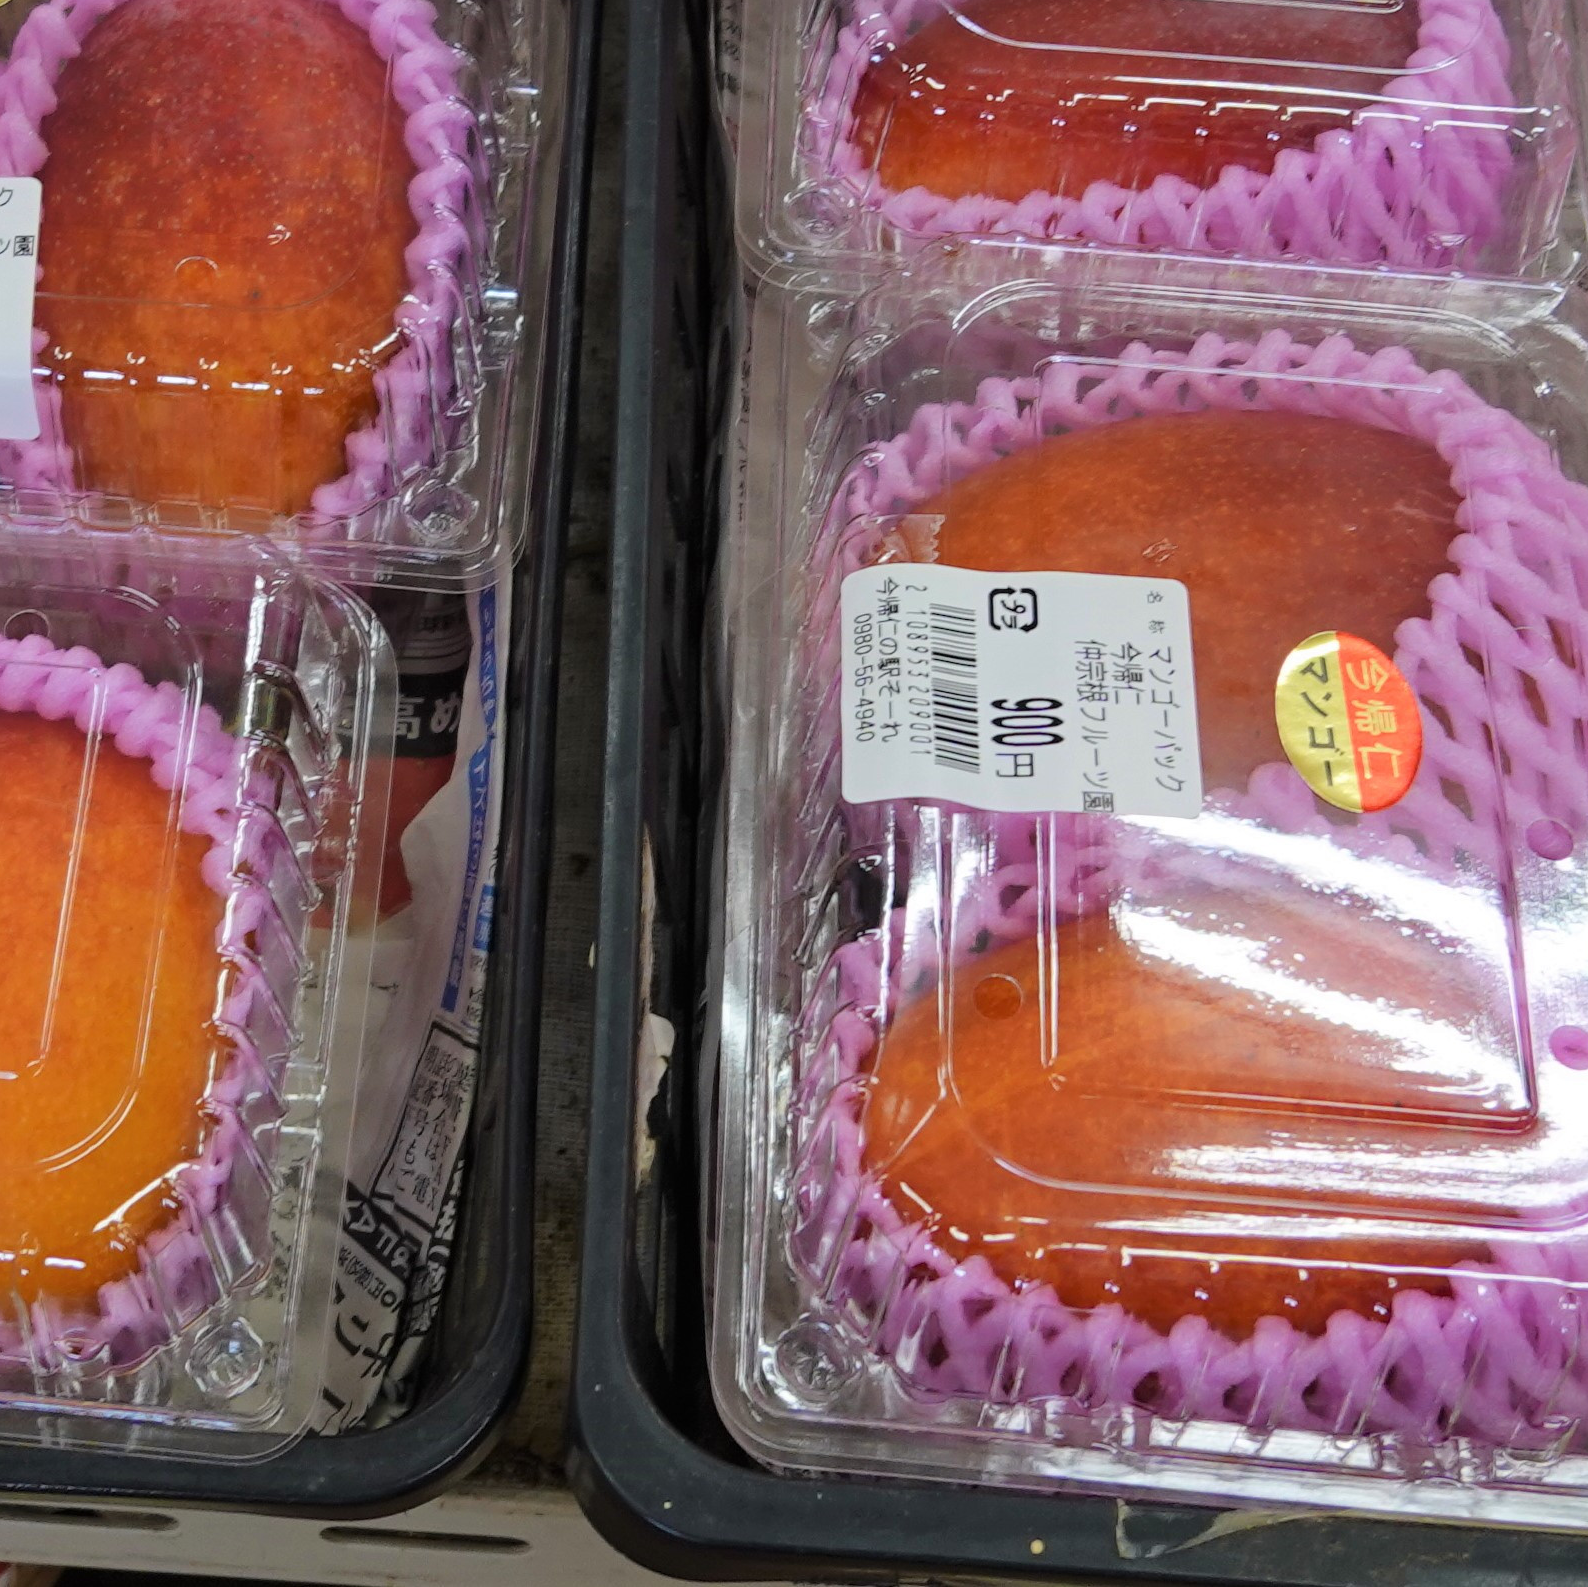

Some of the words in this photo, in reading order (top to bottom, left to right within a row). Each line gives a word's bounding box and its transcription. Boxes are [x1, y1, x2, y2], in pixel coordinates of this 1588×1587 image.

[852, 612, 875, 743] 0980-56-4940
[874, 576, 903, 744] 今帰仁の駅そーれ
[1072, 637, 1115, 813] 仲宗根フルーツ園
[1110, 640, 1143, 707] 今帰仁
[1146, 644, 1186, 795] マンゴーパック
[1299, 654, 1348, 788] マンゴー
[1346, 657, 1402, 780] 今帰仁
[990, 696, 1064, 779] 900円
